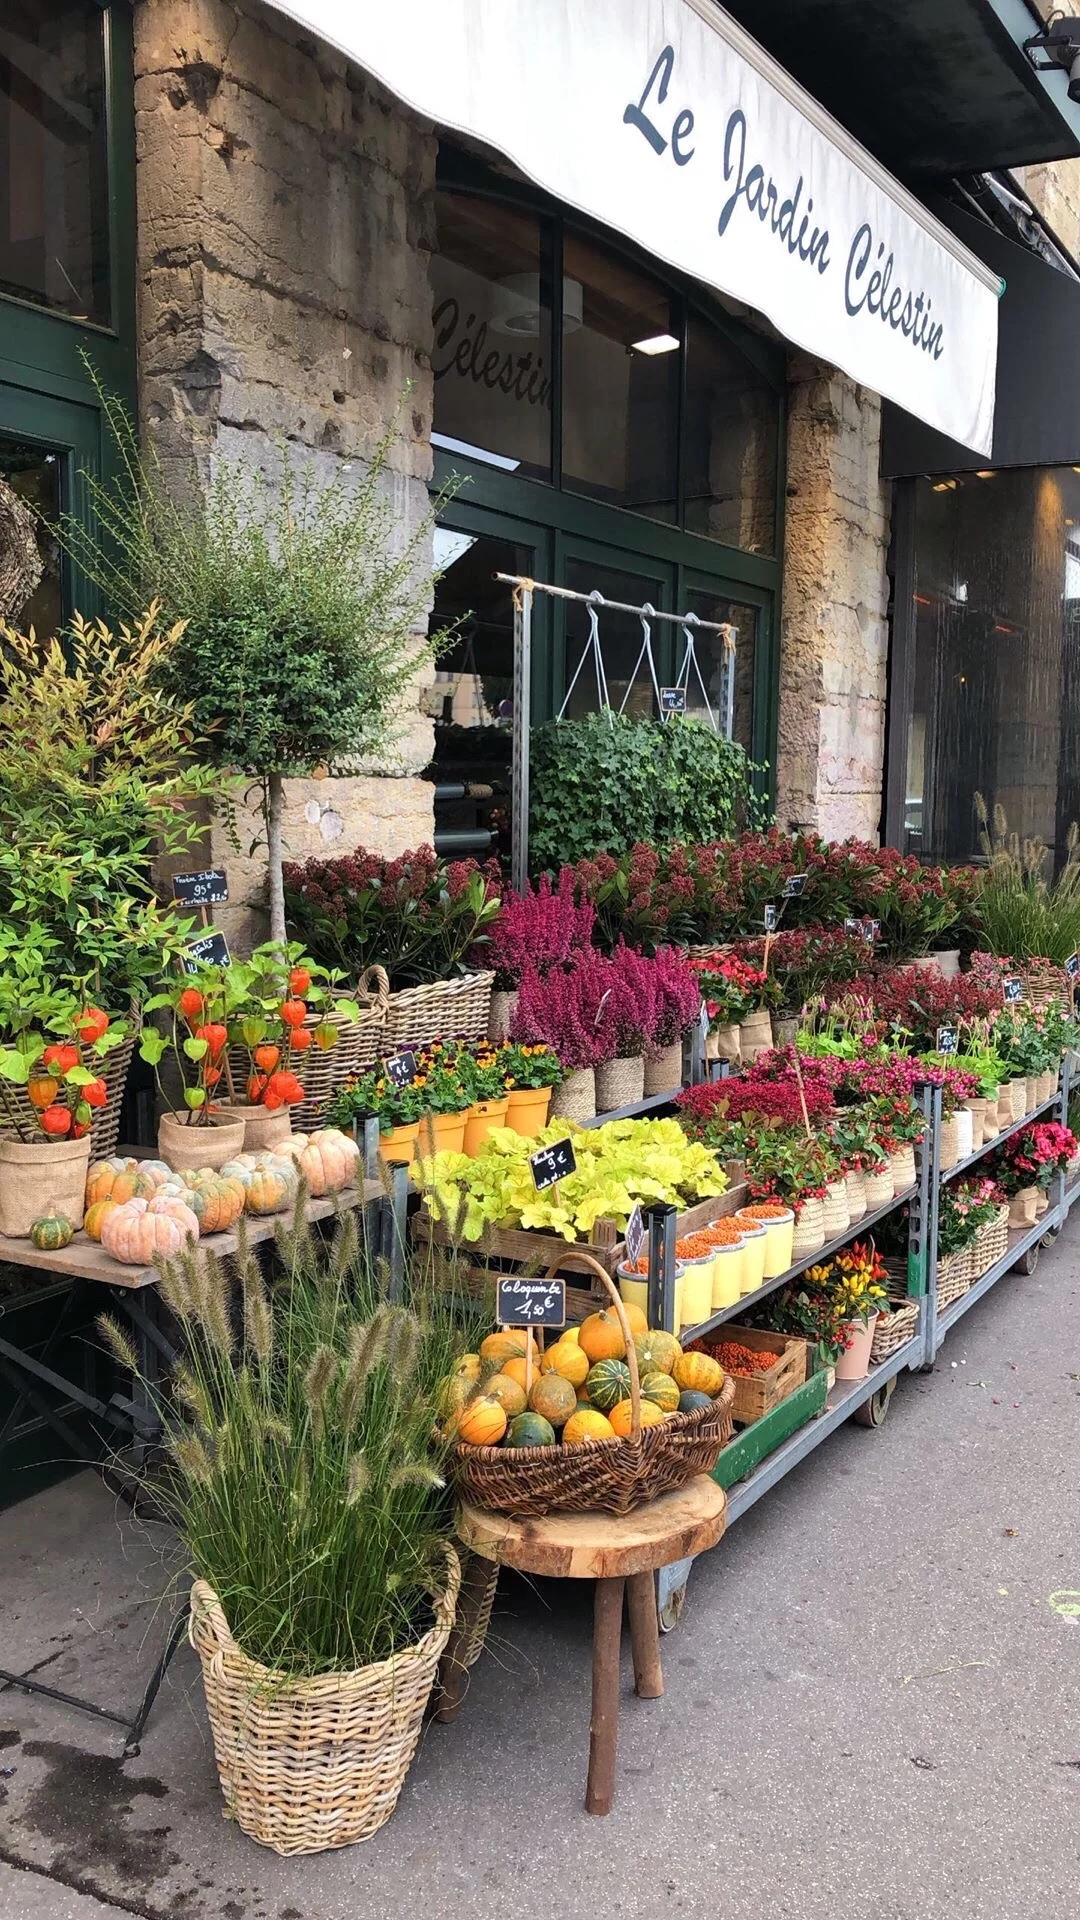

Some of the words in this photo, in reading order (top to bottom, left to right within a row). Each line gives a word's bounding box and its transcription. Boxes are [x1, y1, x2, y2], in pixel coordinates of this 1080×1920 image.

[622, 44, 696, 167] Le
[717, 109, 831, 275] Jardin
[844, 222, 945, 362] Célestin
[501, 1280, 561, 1300] Coloquinte
